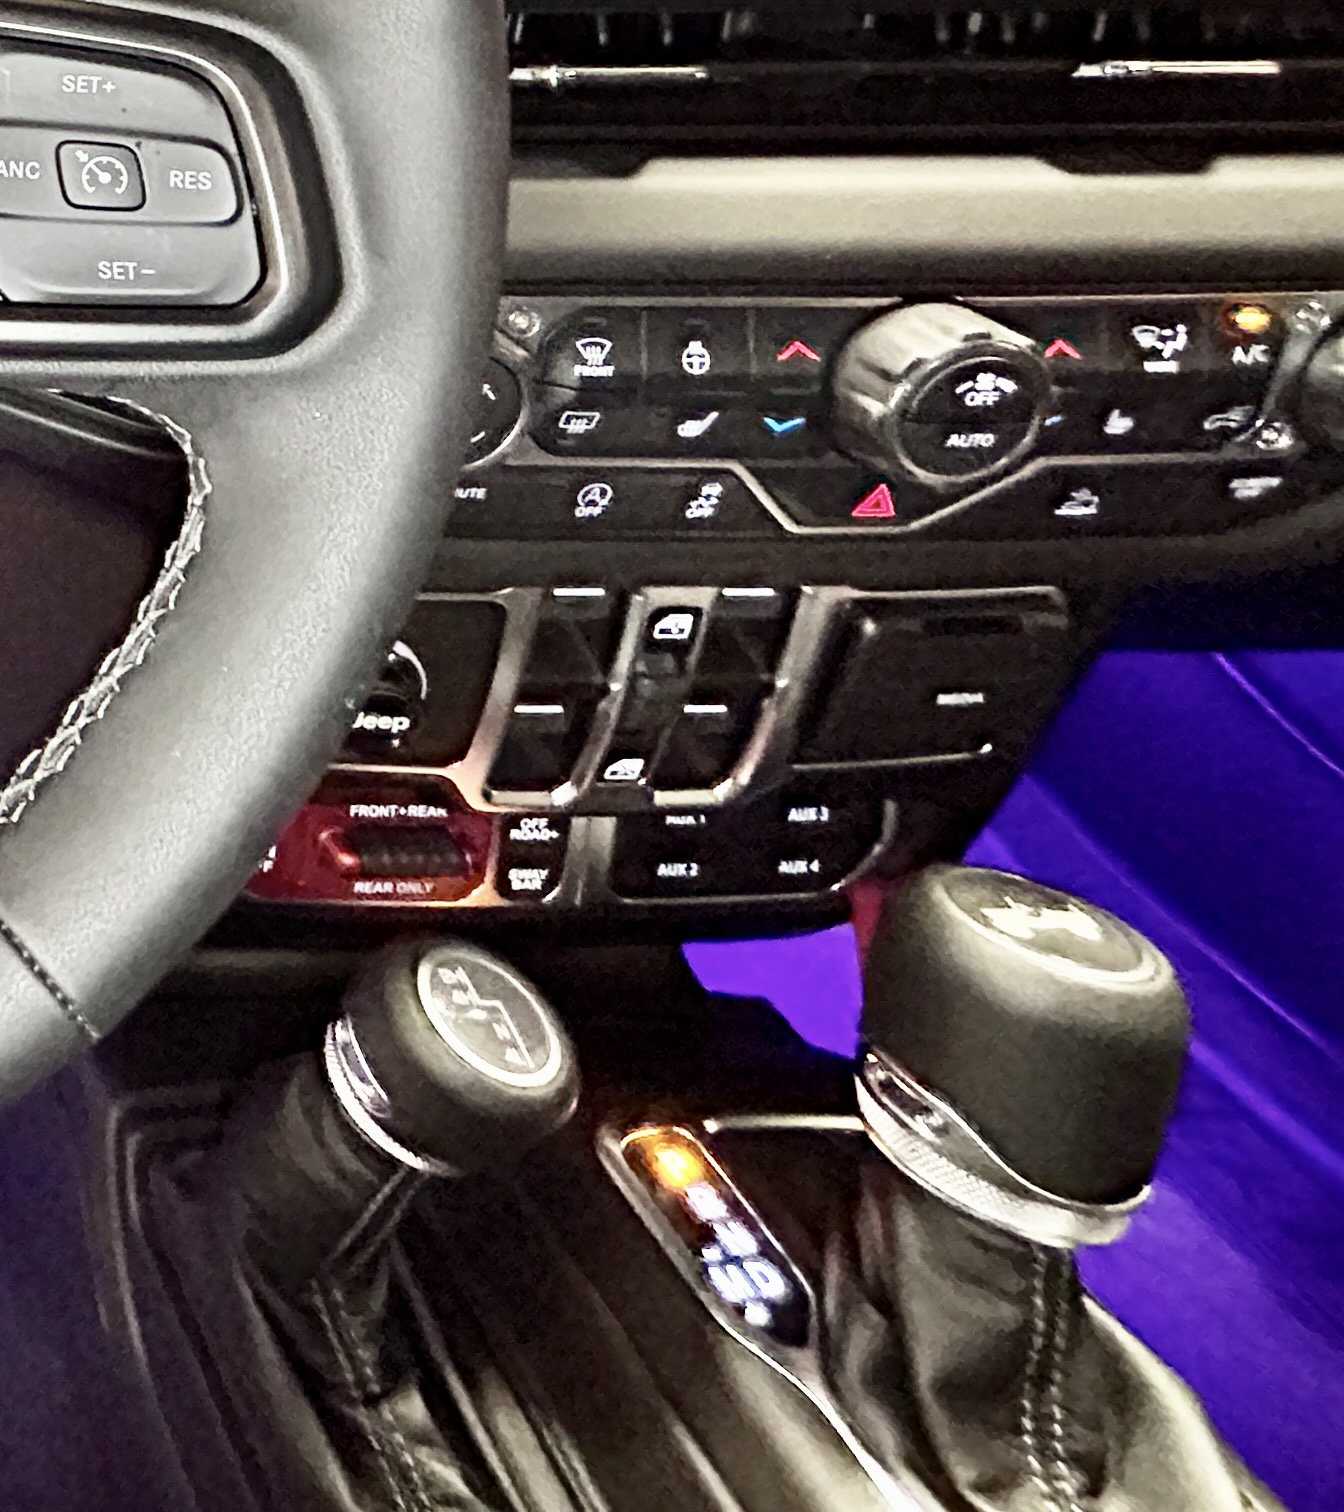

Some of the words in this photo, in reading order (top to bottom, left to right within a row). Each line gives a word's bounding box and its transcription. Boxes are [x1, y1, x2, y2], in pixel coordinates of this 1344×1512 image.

[61, 74, 116, 95] SET+
[168, 170, 212, 191] RES
[1232, 344, 1270, 366] A/C
[574, 365, 615, 377] FRONT
[964, 391, 1000, 407] OFF
[944, 433, 995, 449] AUTO
[575, 505, 604, 518] OFF
[685, 506, 714, 519] OFF
[351, 711, 411, 733] Jeep
[788, 807, 818, 822] AUX
[520, 818, 549, 829] OFF
[657, 863, 687, 877] AUX
[688, 862, 699, 877] 2
[778, 860, 808, 875] AUX
[809, 859, 820, 873] 4
[354, 882, 394, 894] REAR
[396, 882, 434, 894] ONLY
[511, 879, 542, 891] BAR
[743, 1259, 786, 1301] D
